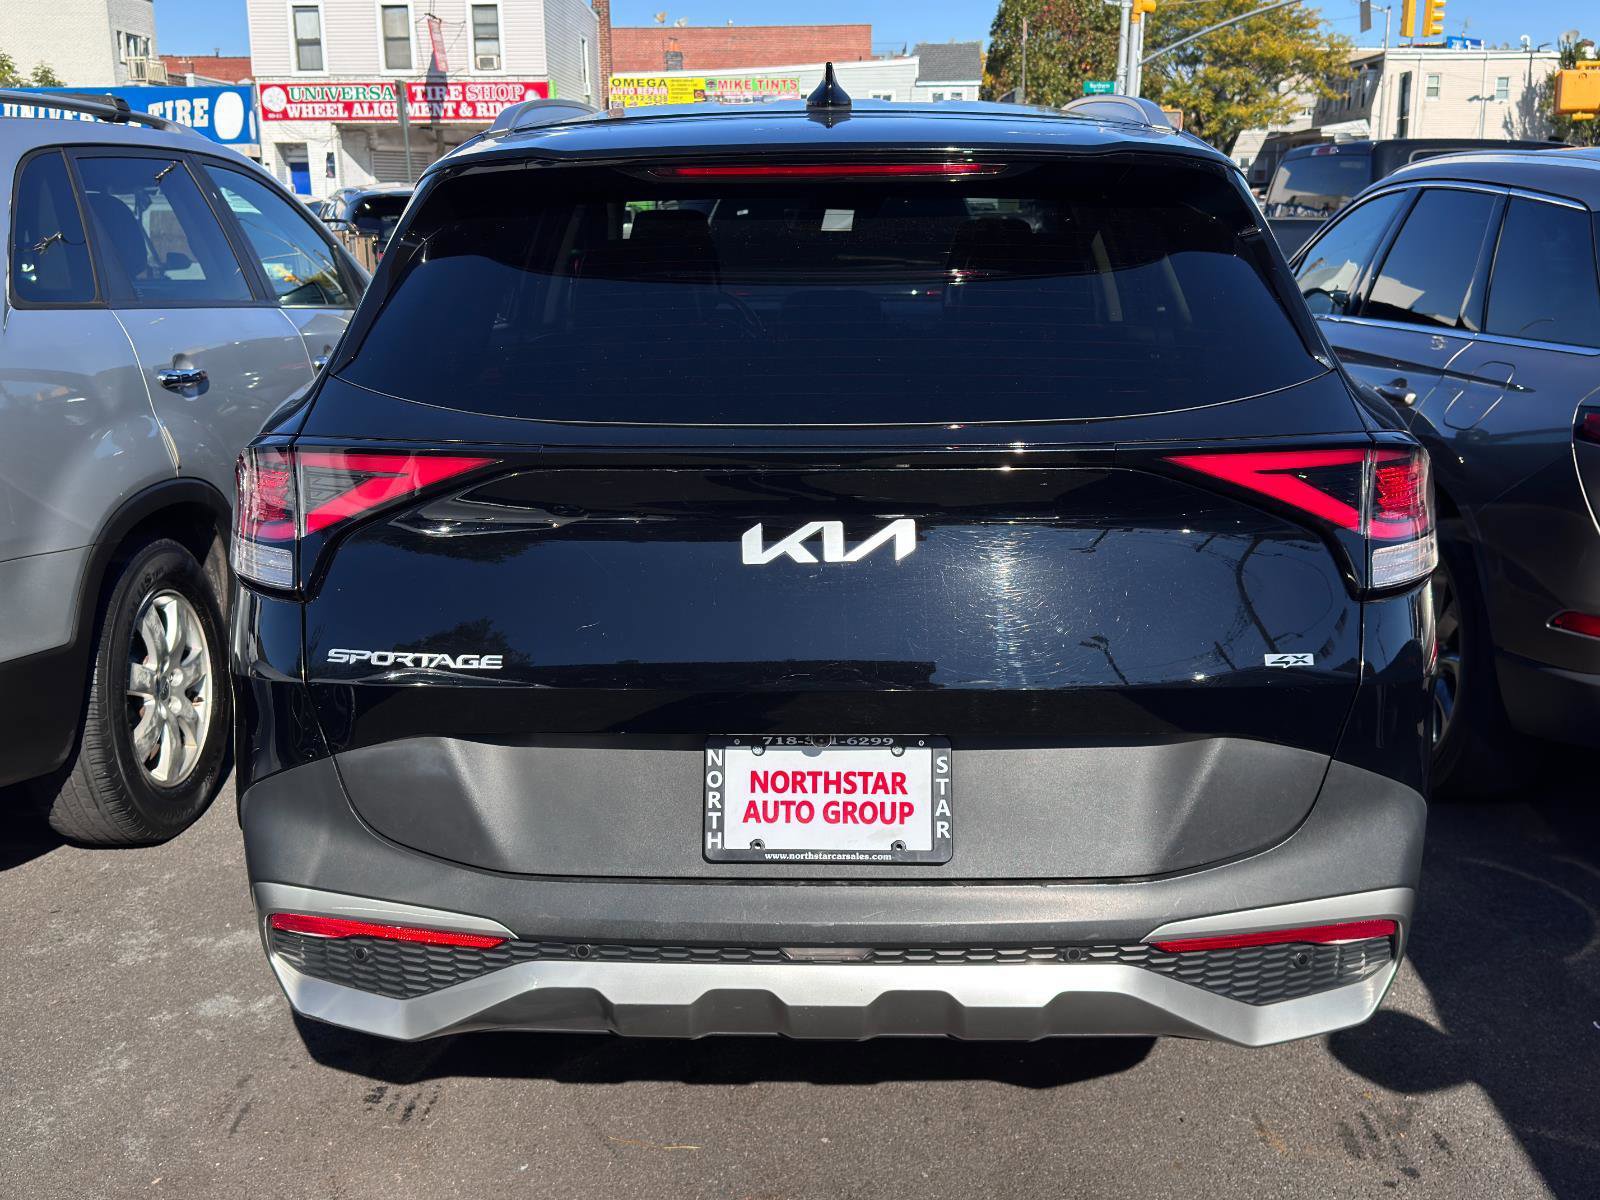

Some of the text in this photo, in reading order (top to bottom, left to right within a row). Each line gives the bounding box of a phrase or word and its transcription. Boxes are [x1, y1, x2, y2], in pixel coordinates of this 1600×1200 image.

[288, 83, 525, 101] UNIVERSA TIRE SHOP
[612, 79, 667, 87] OMEGA
[717, 79, 798, 90] MIKE TINTS
[148, 98, 209, 127] TIRE
[286, 103, 348, 118] WHEEL
[459, 103, 474, 117] &
[742, 519, 916, 564] KIA
[327, 648, 503, 669] SPORTAGE
[750, 770, 908, 795] NORTHSTAR
[707, 749, 723, 849] NORTH
[935, 756, 951, 839] STAR
[743, 800, 915, 825] AUTO GROUP
[765, 851, 892, 861] www.northstarcarsales.com
